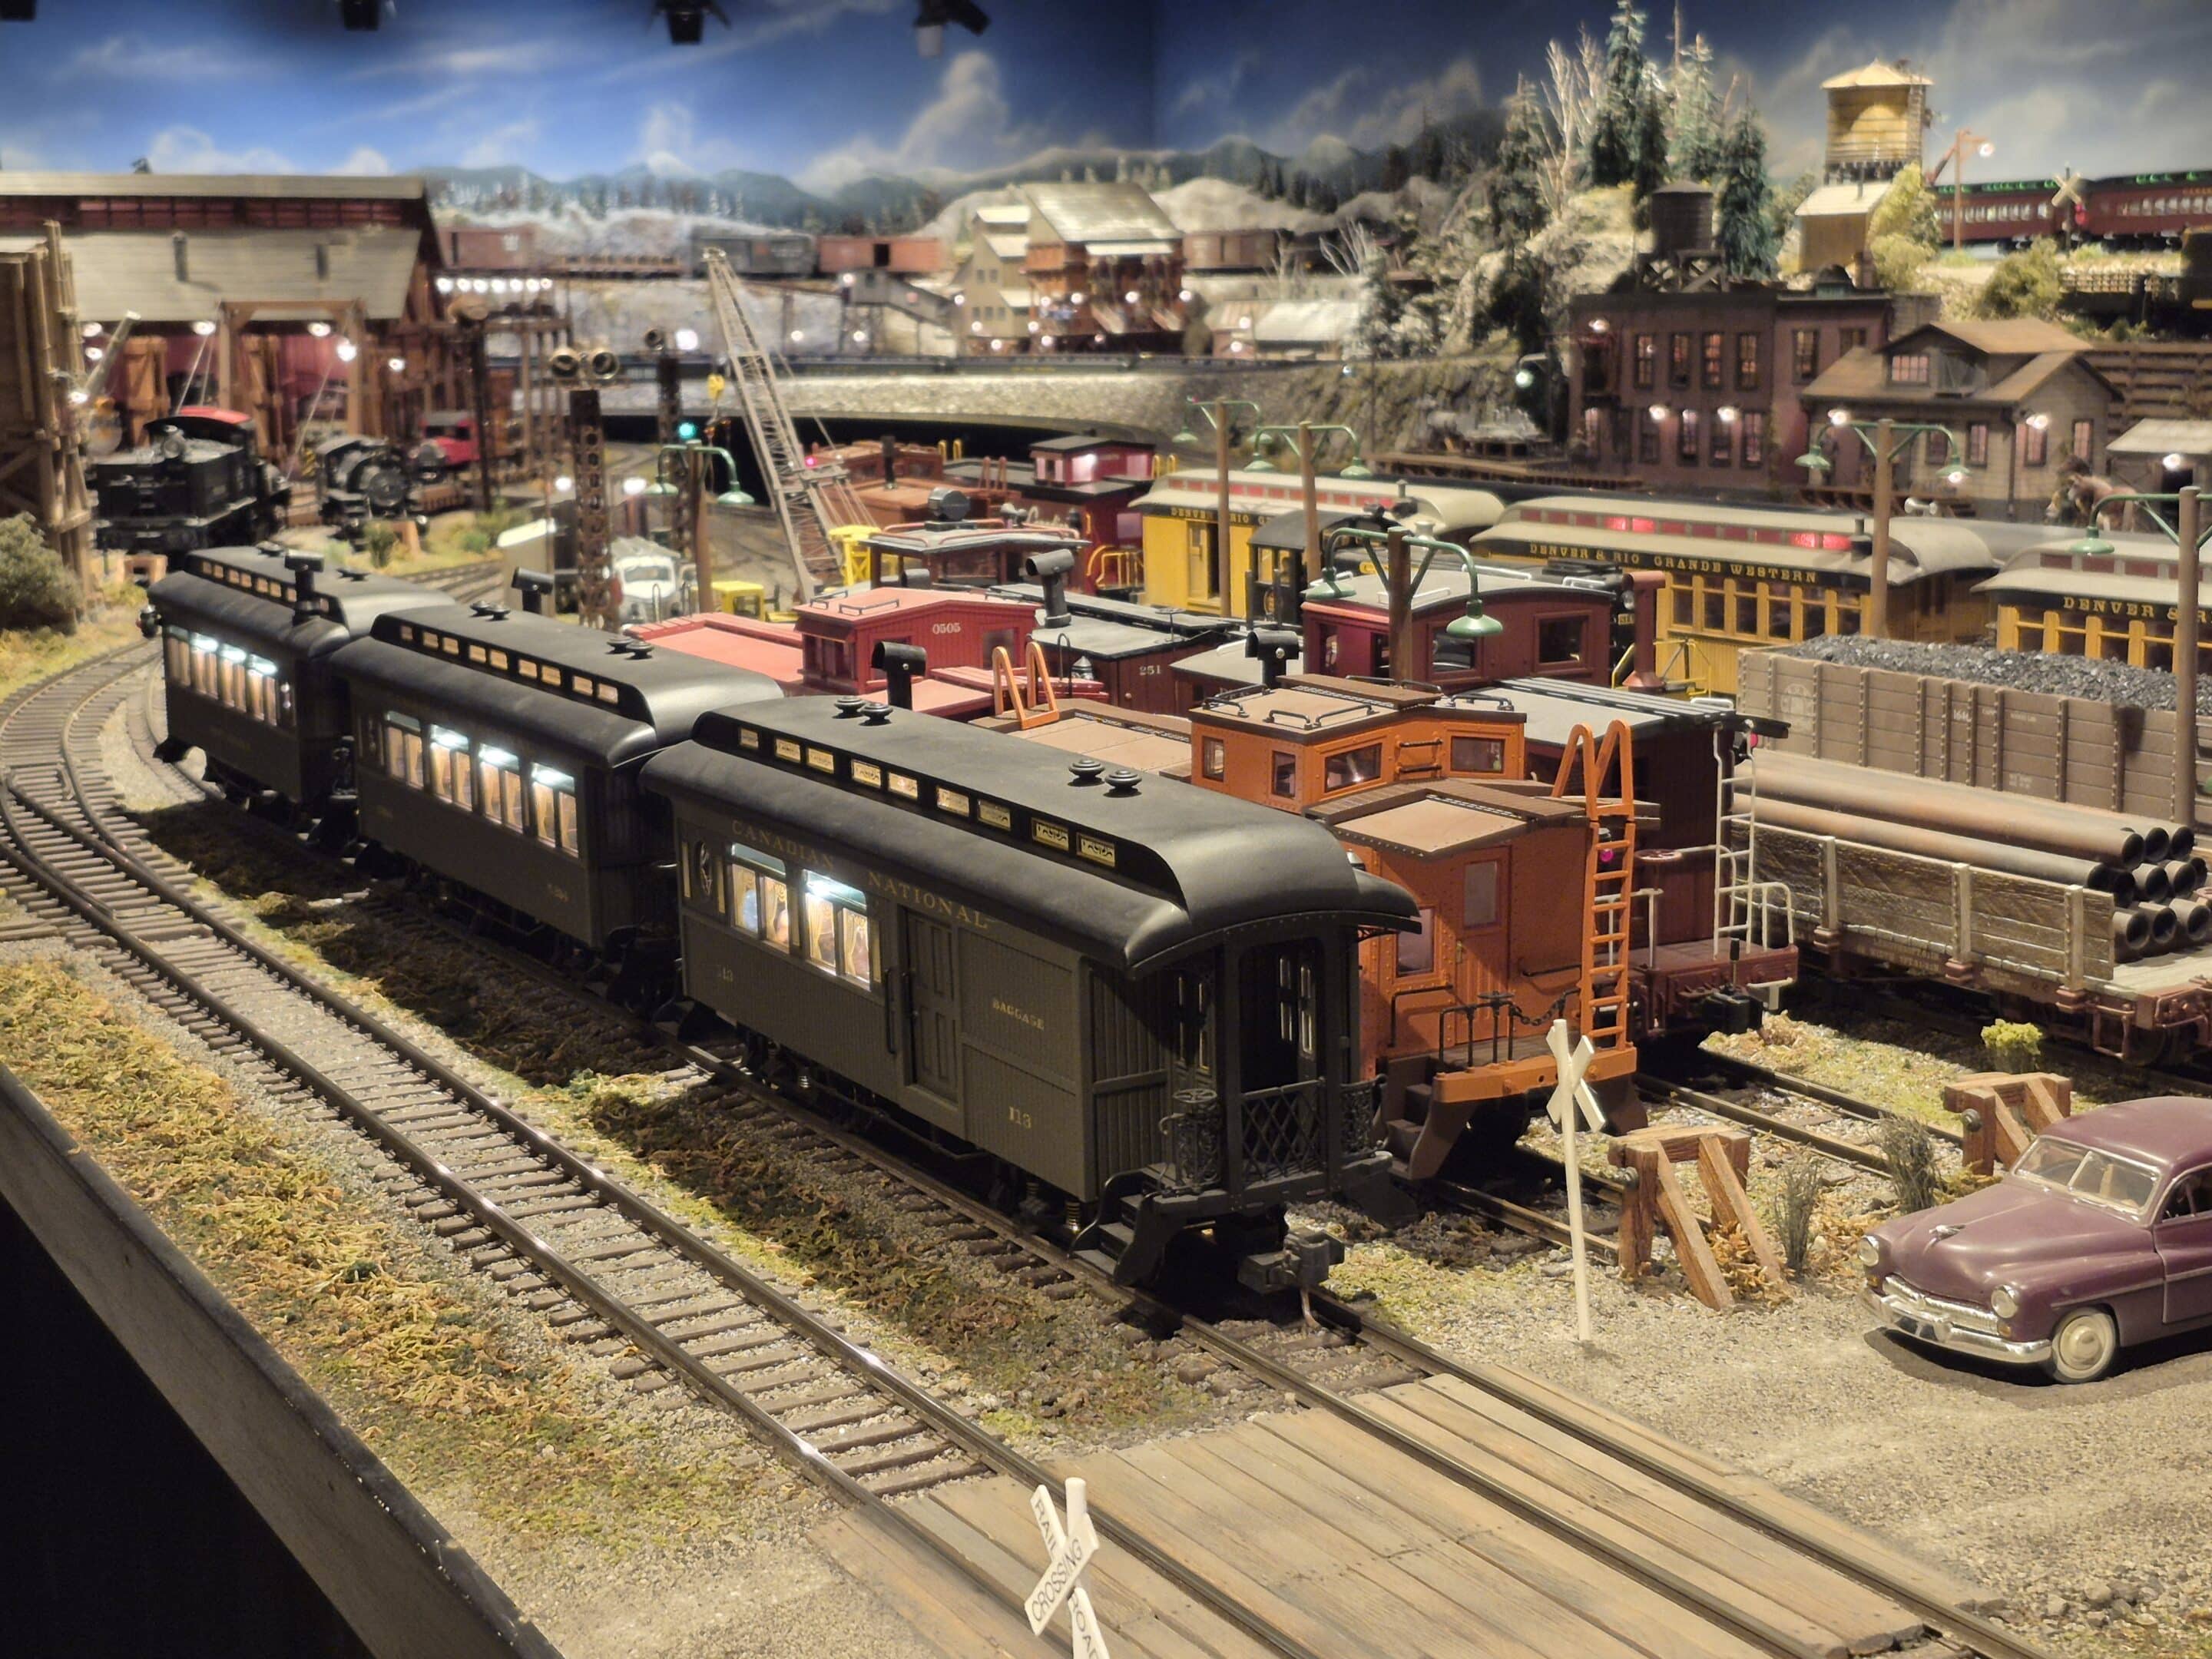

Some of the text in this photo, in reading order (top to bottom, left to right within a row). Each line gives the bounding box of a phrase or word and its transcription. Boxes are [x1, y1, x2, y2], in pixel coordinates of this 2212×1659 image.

[1529, 543, 1816, 584] DENVER & RIO GRANDE WESTERN
[2064, 596, 2154, 618] DENVER
[1139, 664, 1161, 676] 251
[732, 819, 988, 929] CANADIAN NATIONAL
[992, 999, 1045, 1031] BAGGAGE
[1035, 1498, 1058, 1552] RAIL
[1031, 1538, 1082, 1621] CROSSING
